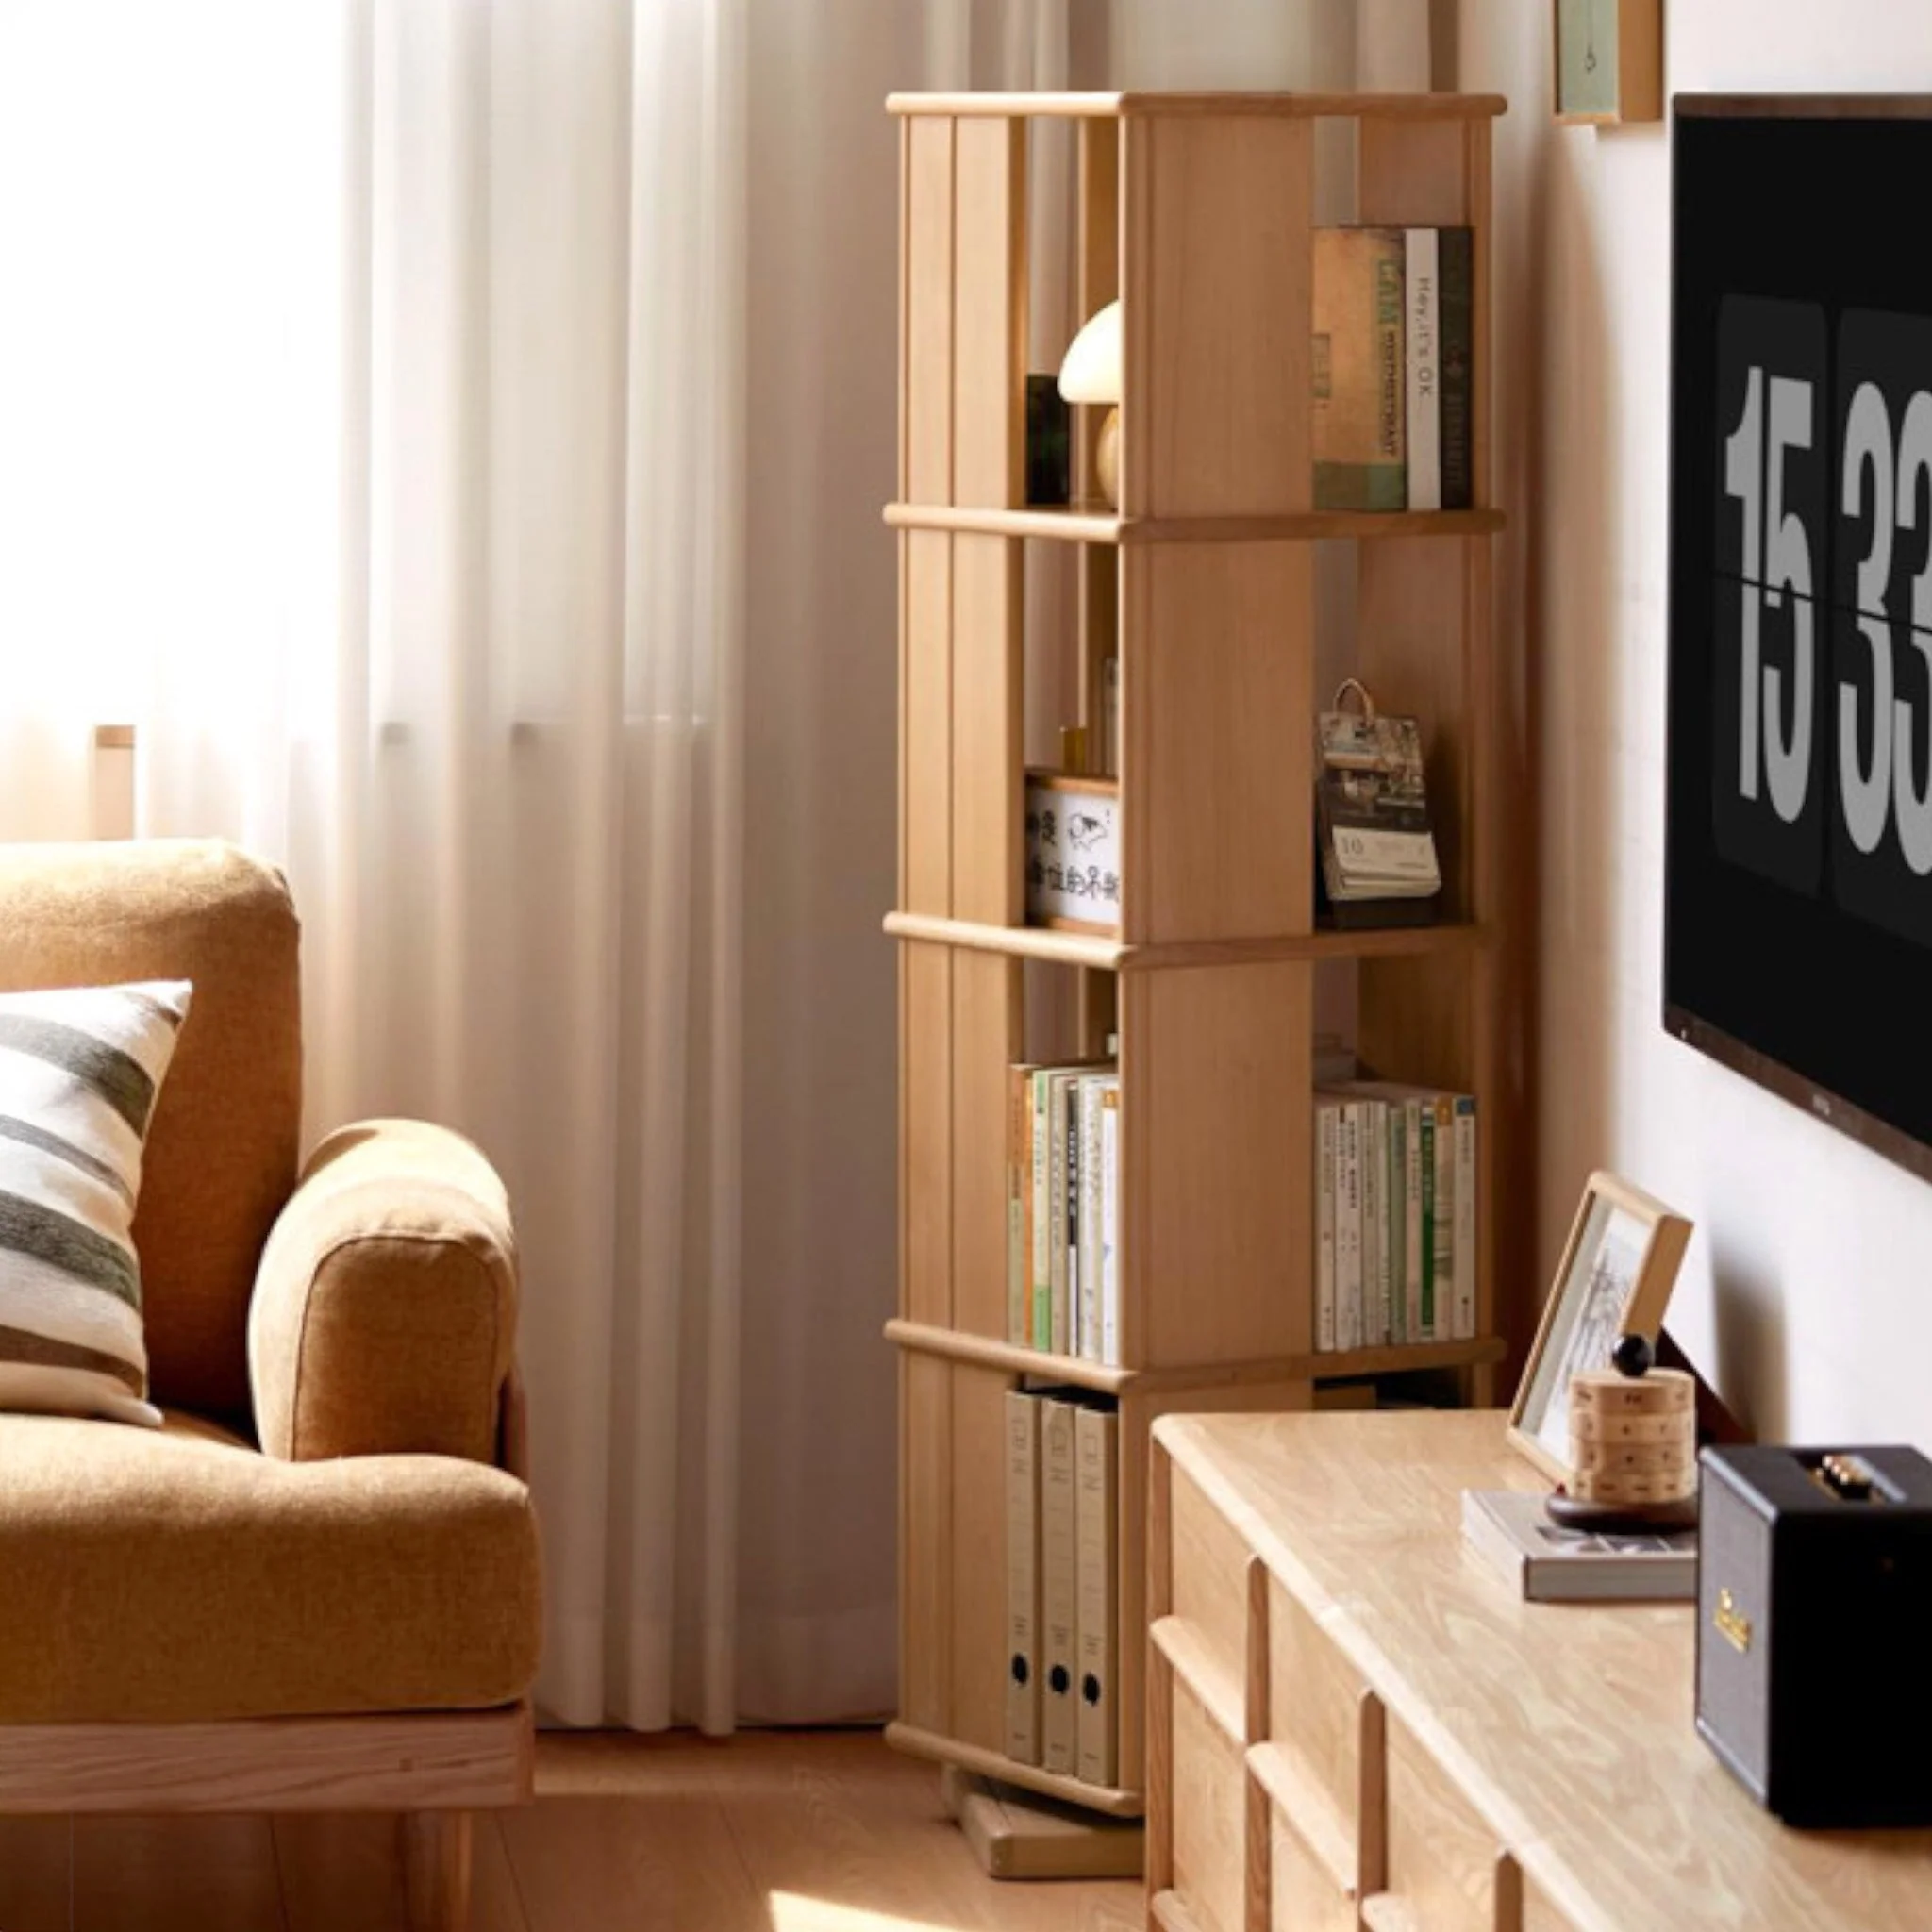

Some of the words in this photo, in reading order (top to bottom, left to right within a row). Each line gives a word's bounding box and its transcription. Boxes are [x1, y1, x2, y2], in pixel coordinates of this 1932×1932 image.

[1418, 366, 1433, 396] OK
[1725, 366, 1815, 824] 15
[1839, 381, 1932, 876] 33
